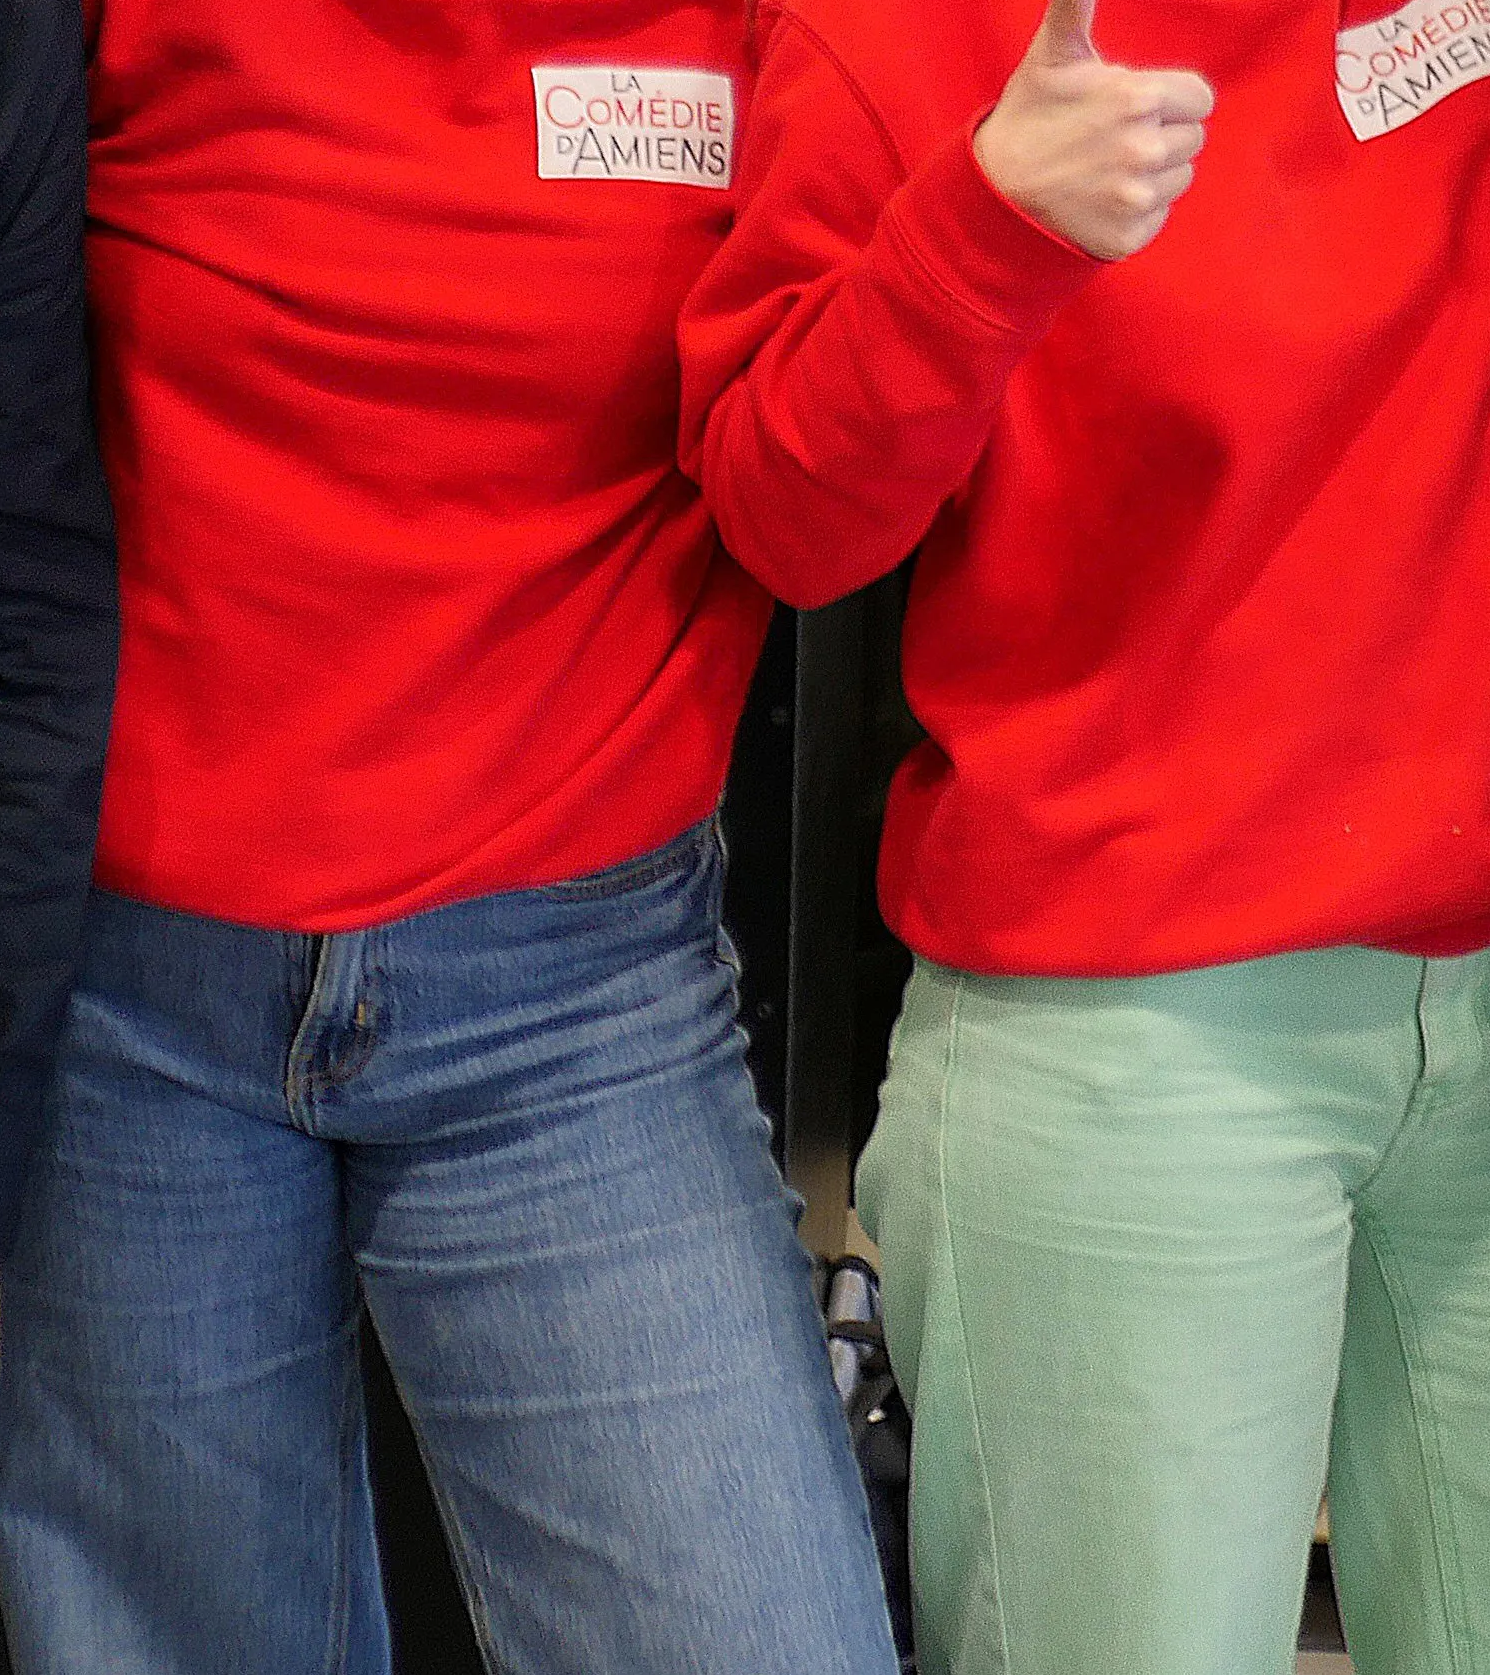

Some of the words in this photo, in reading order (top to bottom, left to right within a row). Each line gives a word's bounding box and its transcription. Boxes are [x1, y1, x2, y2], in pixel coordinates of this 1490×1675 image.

[1377, 19, 1409, 42] LA
[611, 71, 643, 94] LA
[545, 85, 723, 134] COMÉDIE
[556, 127, 726, 176] D'AMIENS
